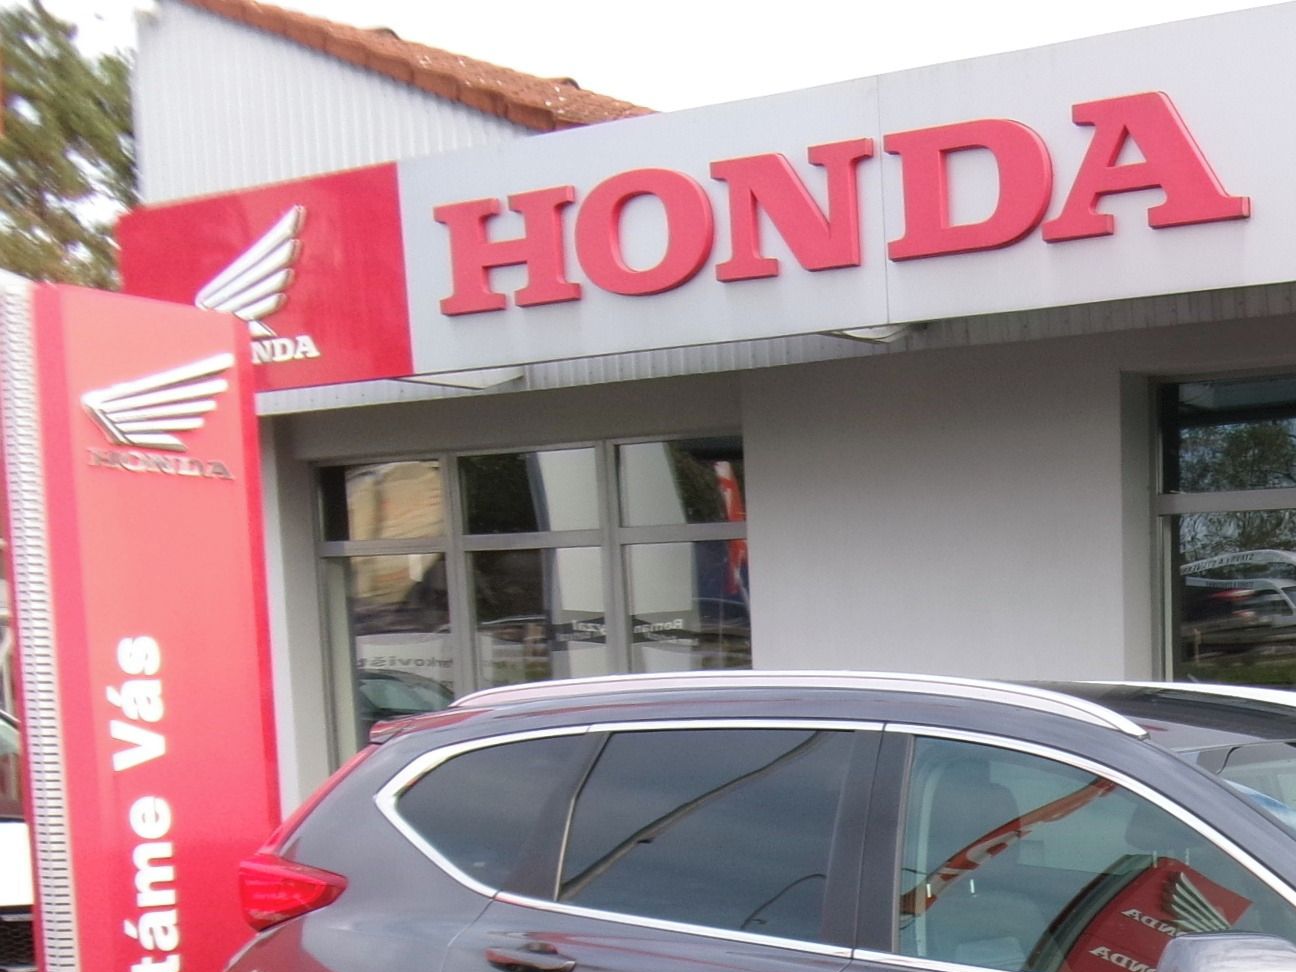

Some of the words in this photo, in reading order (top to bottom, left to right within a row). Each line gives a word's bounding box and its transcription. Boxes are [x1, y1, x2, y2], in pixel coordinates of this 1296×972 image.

[433, 91, 1251, 316] HONDA
[250, 335, 320, 364] NDA
[88, 448, 235, 480] HONDA
[106, 635, 167, 772] Vás
